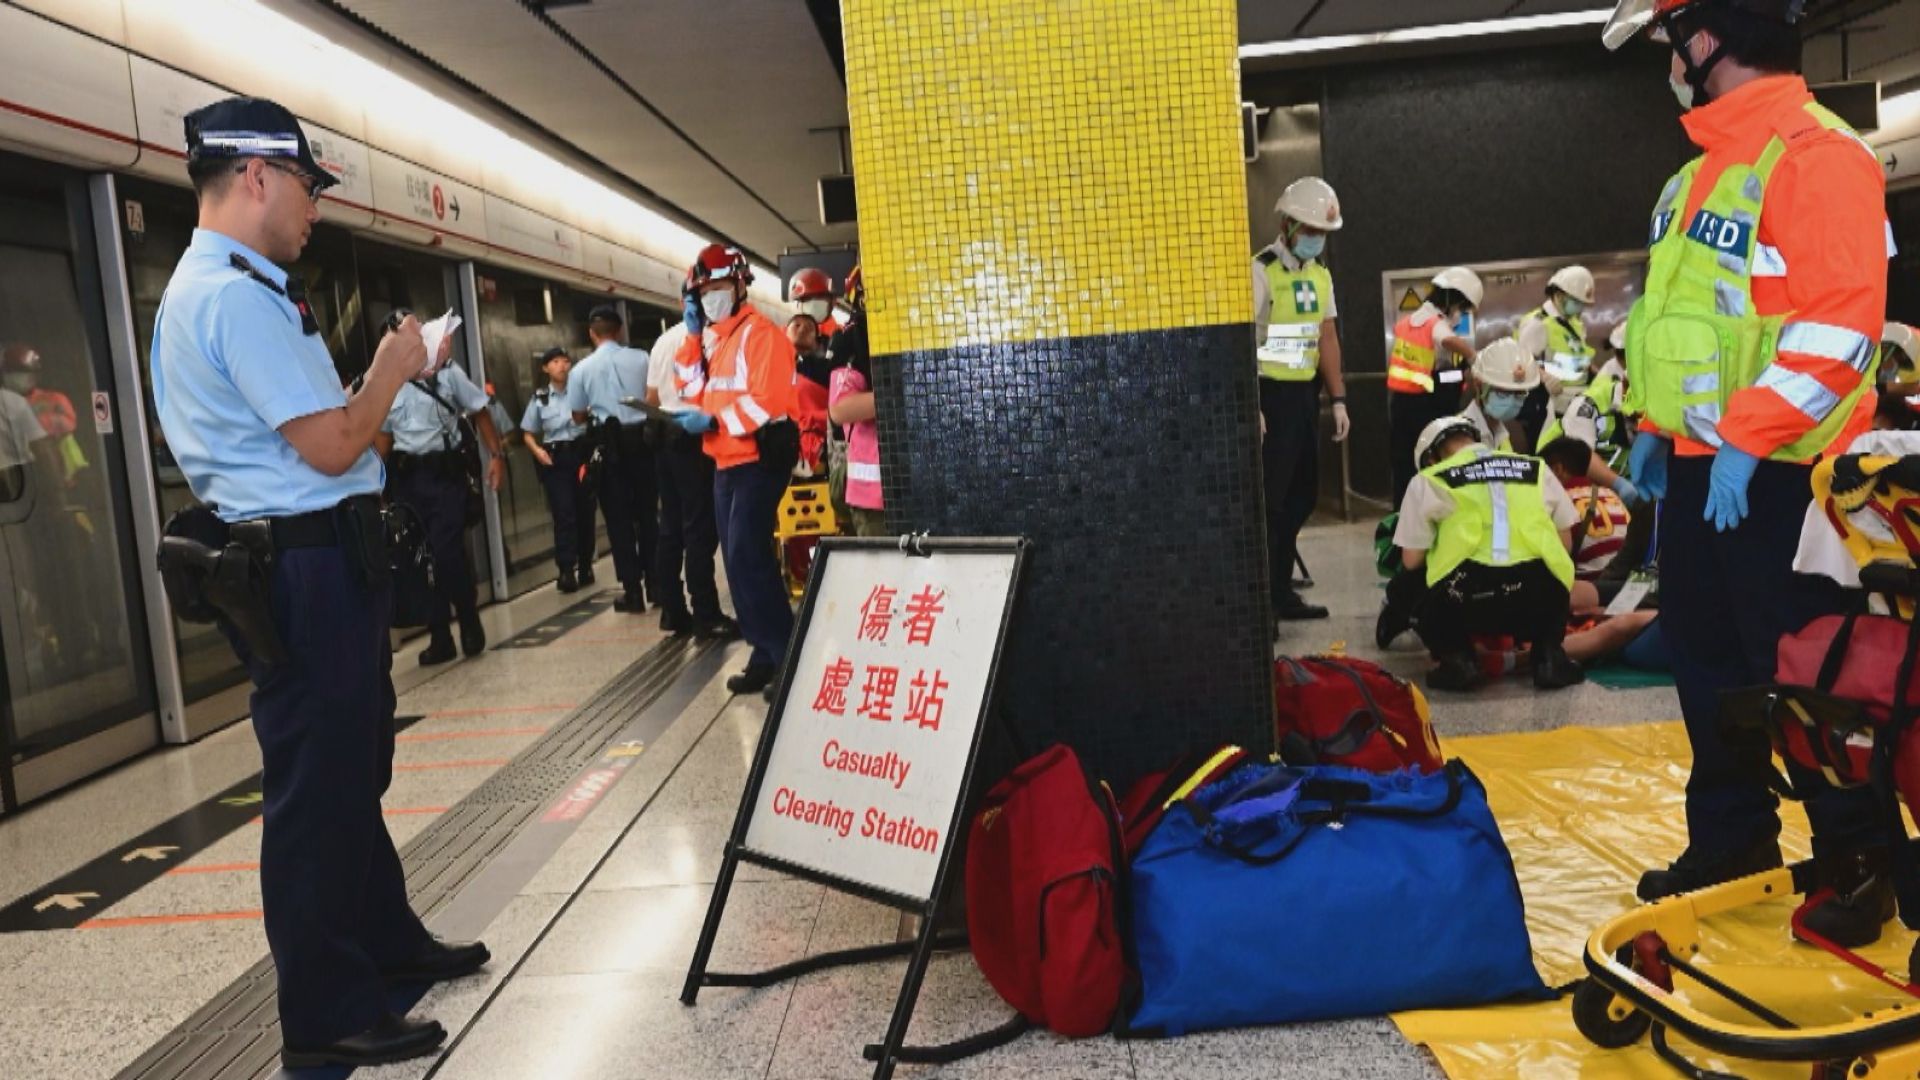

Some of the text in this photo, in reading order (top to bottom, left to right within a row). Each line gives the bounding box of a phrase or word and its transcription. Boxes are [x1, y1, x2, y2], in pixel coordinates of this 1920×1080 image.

[858, 584, 944, 647] 傷者
[812, 656, 949, 731] 處理站
[822, 739, 911, 789] Casualty
[773, 787, 939, 854] Clearing Station
